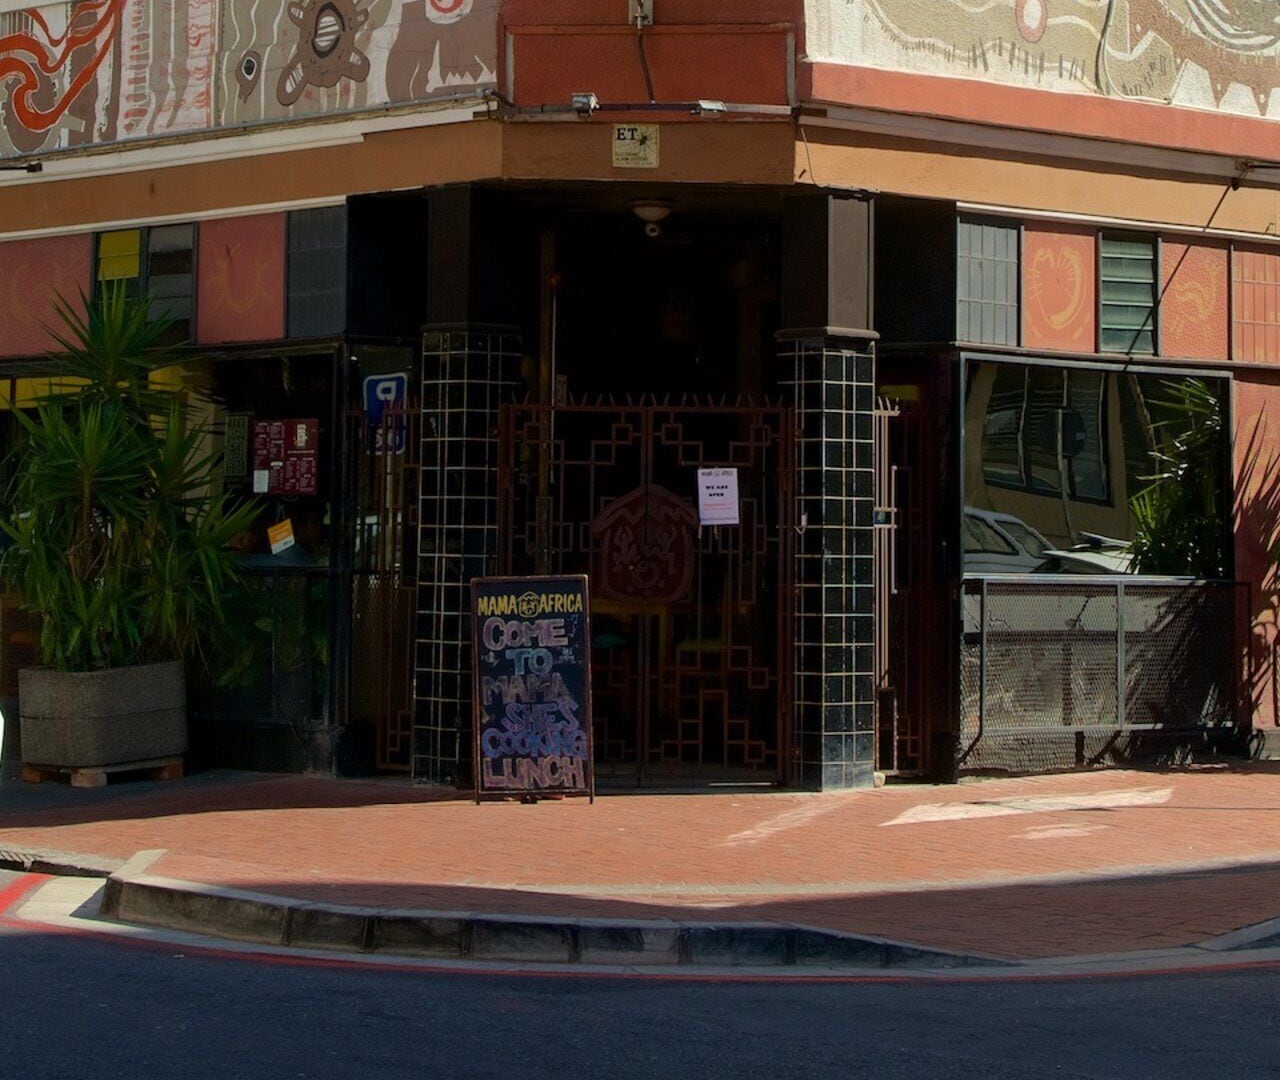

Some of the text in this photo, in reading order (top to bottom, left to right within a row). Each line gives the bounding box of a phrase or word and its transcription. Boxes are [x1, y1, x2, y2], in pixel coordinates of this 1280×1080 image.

[476, 593, 583, 617] MAMA AFRICA
[482, 616, 569, 651] COME
[505, 647, 554, 675] TO
[482, 672, 574, 706] MAMA
[482, 728, 587, 760] COOKING
[483, 754, 586, 788] LUNCH
